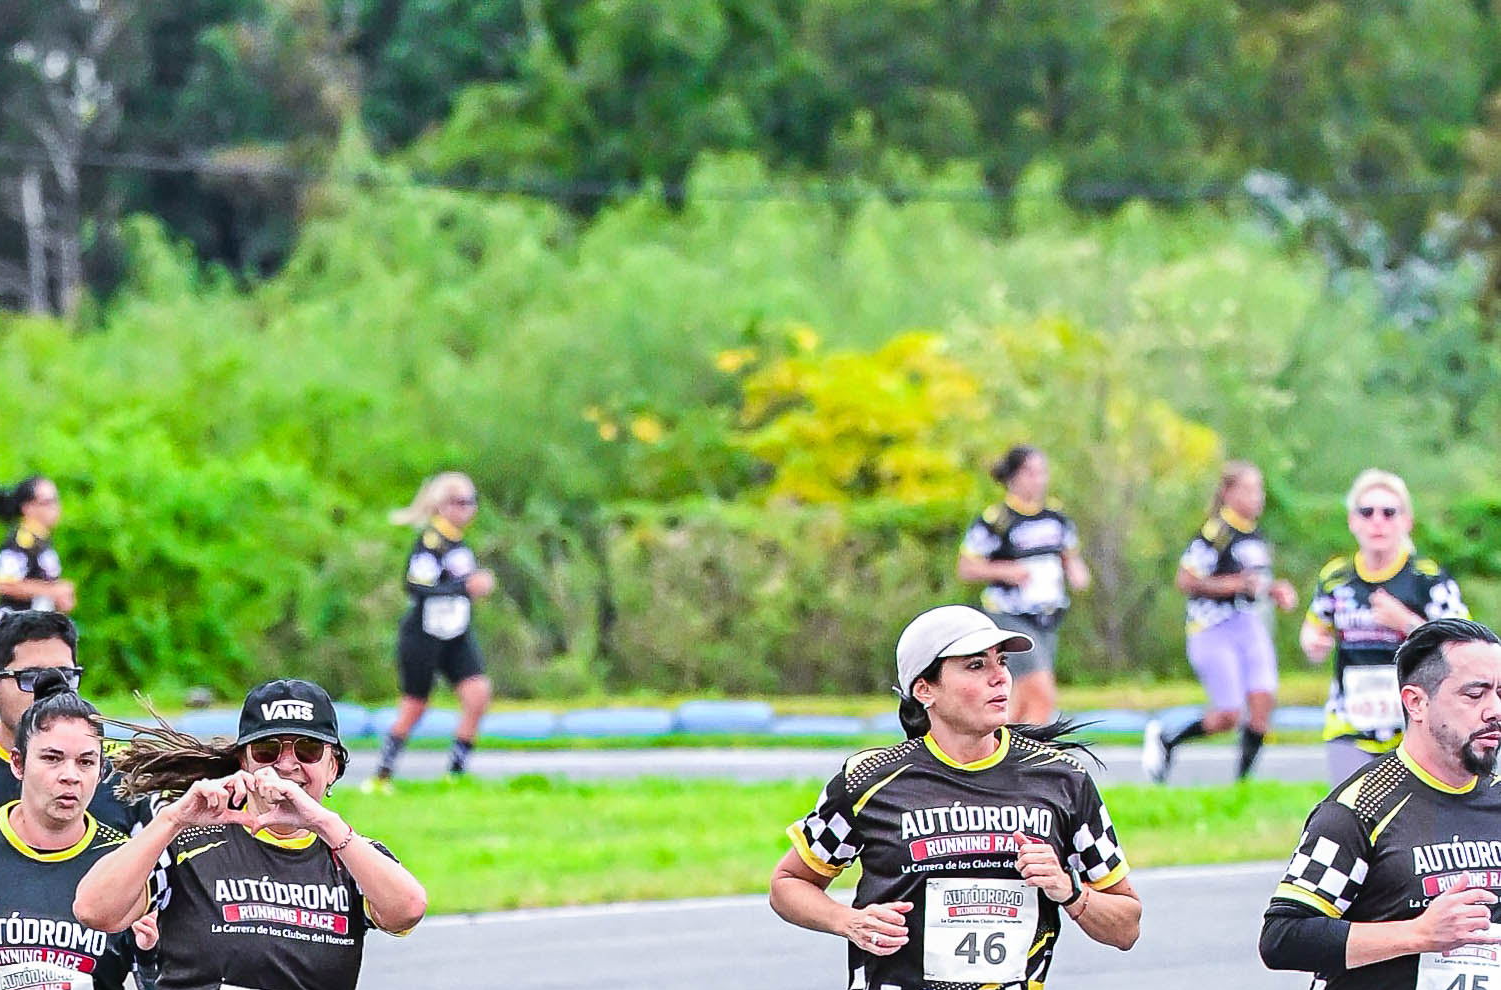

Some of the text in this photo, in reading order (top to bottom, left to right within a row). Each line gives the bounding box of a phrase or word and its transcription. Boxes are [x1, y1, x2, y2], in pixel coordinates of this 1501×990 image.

[260, 699, 314, 721] VANS
[901, 801, 1053, 840] AUTÓDROMO
[925, 834, 991, 857] RUNNING
[1412, 834, 1501, 875] AUTÓDRO
[911, 860, 943, 872] Carrera
[945, 860, 957, 870] de
[958, 859, 971, 869] los
[972, 859, 1001, 869] Clubes
[1002, 859, 1015, 868] de
[215, 875, 350, 912] AUTÓDROMO
[943, 884, 1024, 906] AUTÓDROMO
[1409, 899, 1421, 908] La
[238, 903, 335, 930] RUNNING RACE
[211, 923, 222, 933] La
[223, 924, 255, 934] Carrera
[257, 925, 268, 935] de
[269, 926, 281, 937] los
[282, 929, 311, 942] Clubes
[312, 932, 324, 943] del
[954, 932, 1007, 965] 46
[47, 950, 83, 970] RACE
